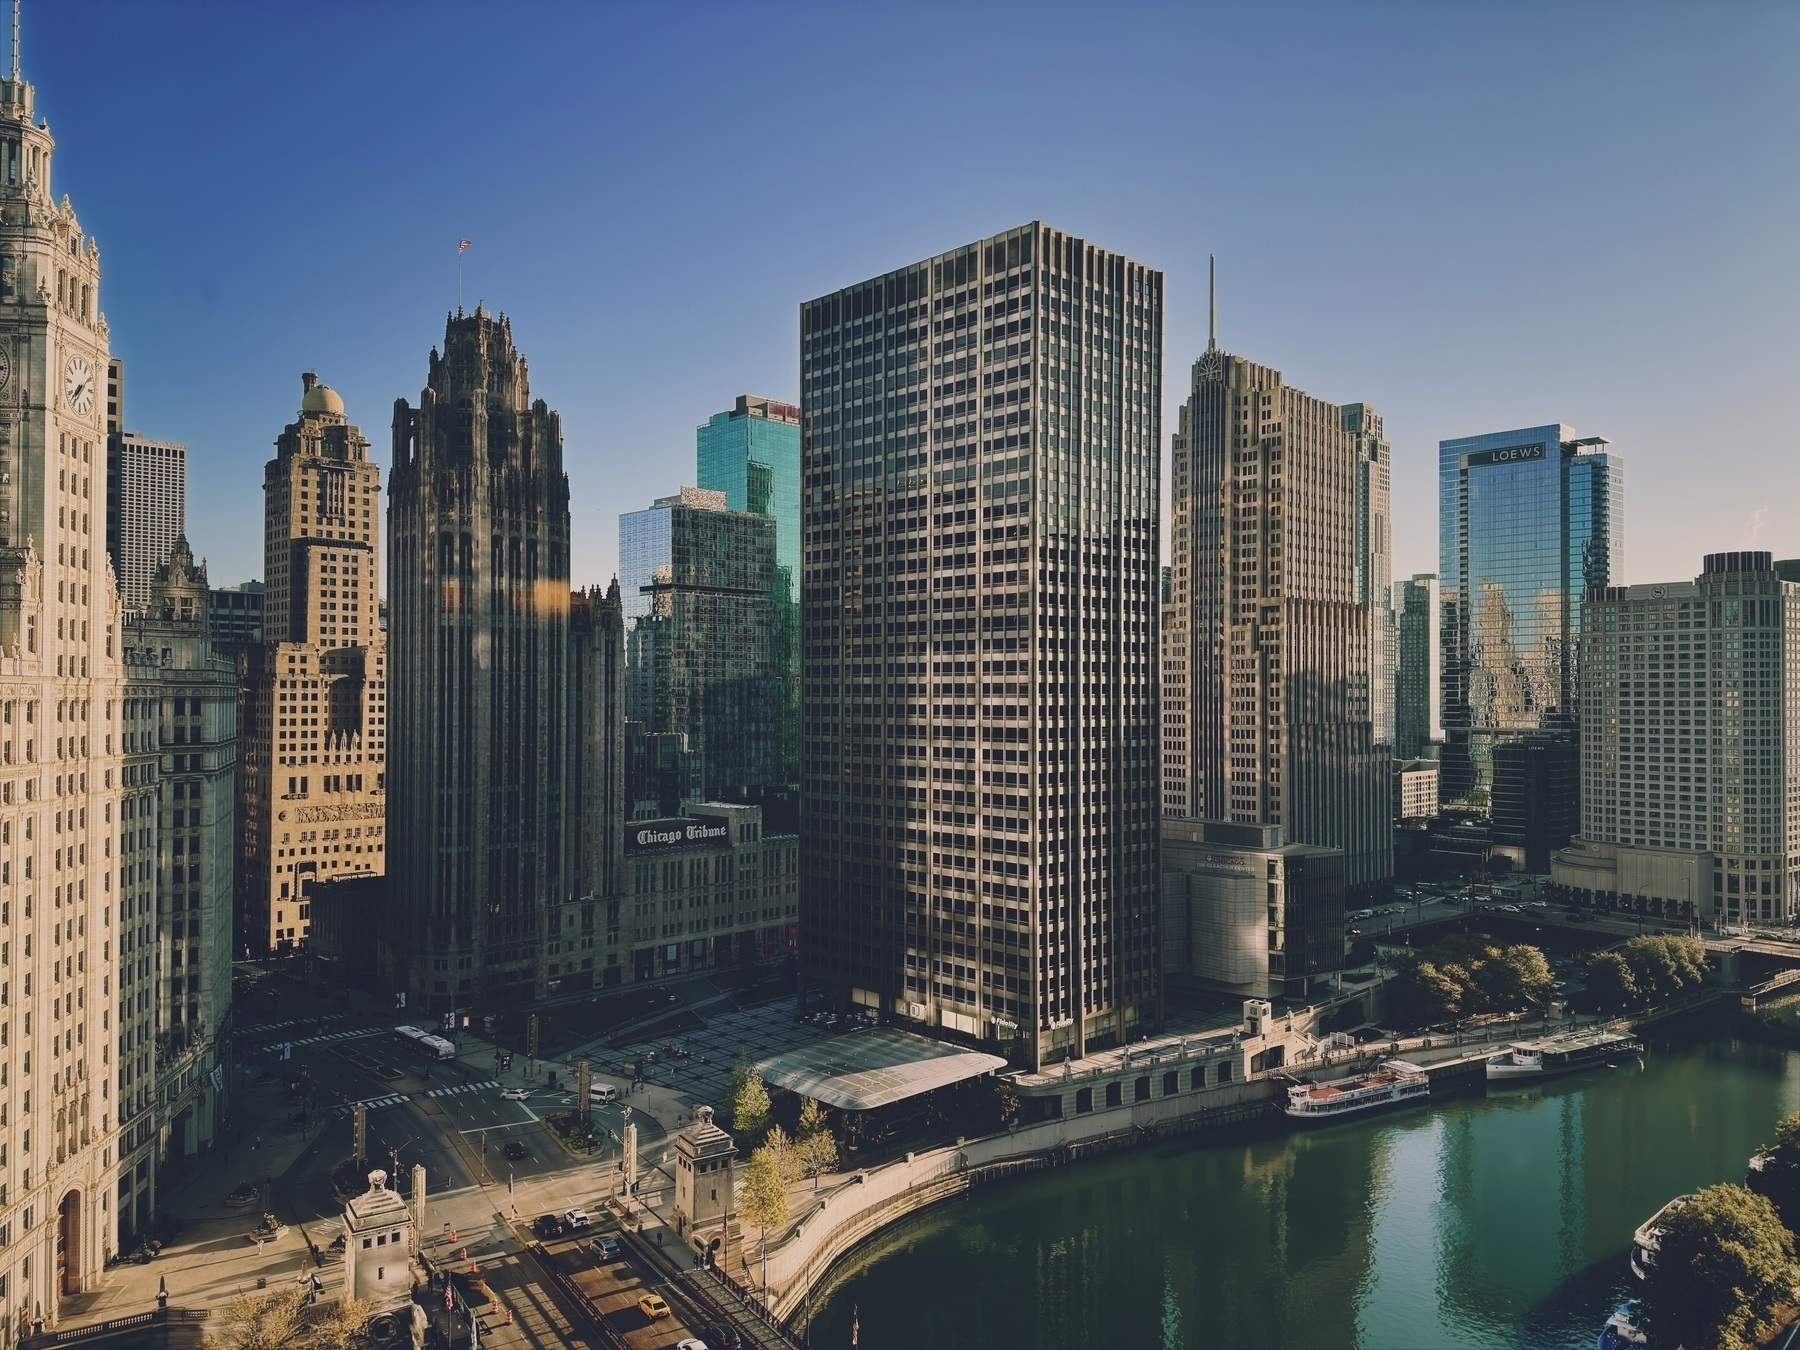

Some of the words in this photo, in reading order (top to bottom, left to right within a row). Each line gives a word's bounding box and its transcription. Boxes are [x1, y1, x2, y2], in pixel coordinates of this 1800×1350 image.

[1492, 446, 1540, 462] LOEWS
[636, 829, 682, 845] Chicago
[686, 825, 727, 840] Tribune
[1213, 858, 1245, 866] CHICAGO
[1492, 888, 1502, 896] IPA
[996, 1017, 1018, 1030] Fidelity
[1056, 1018, 1074, 1029] Fidelity
